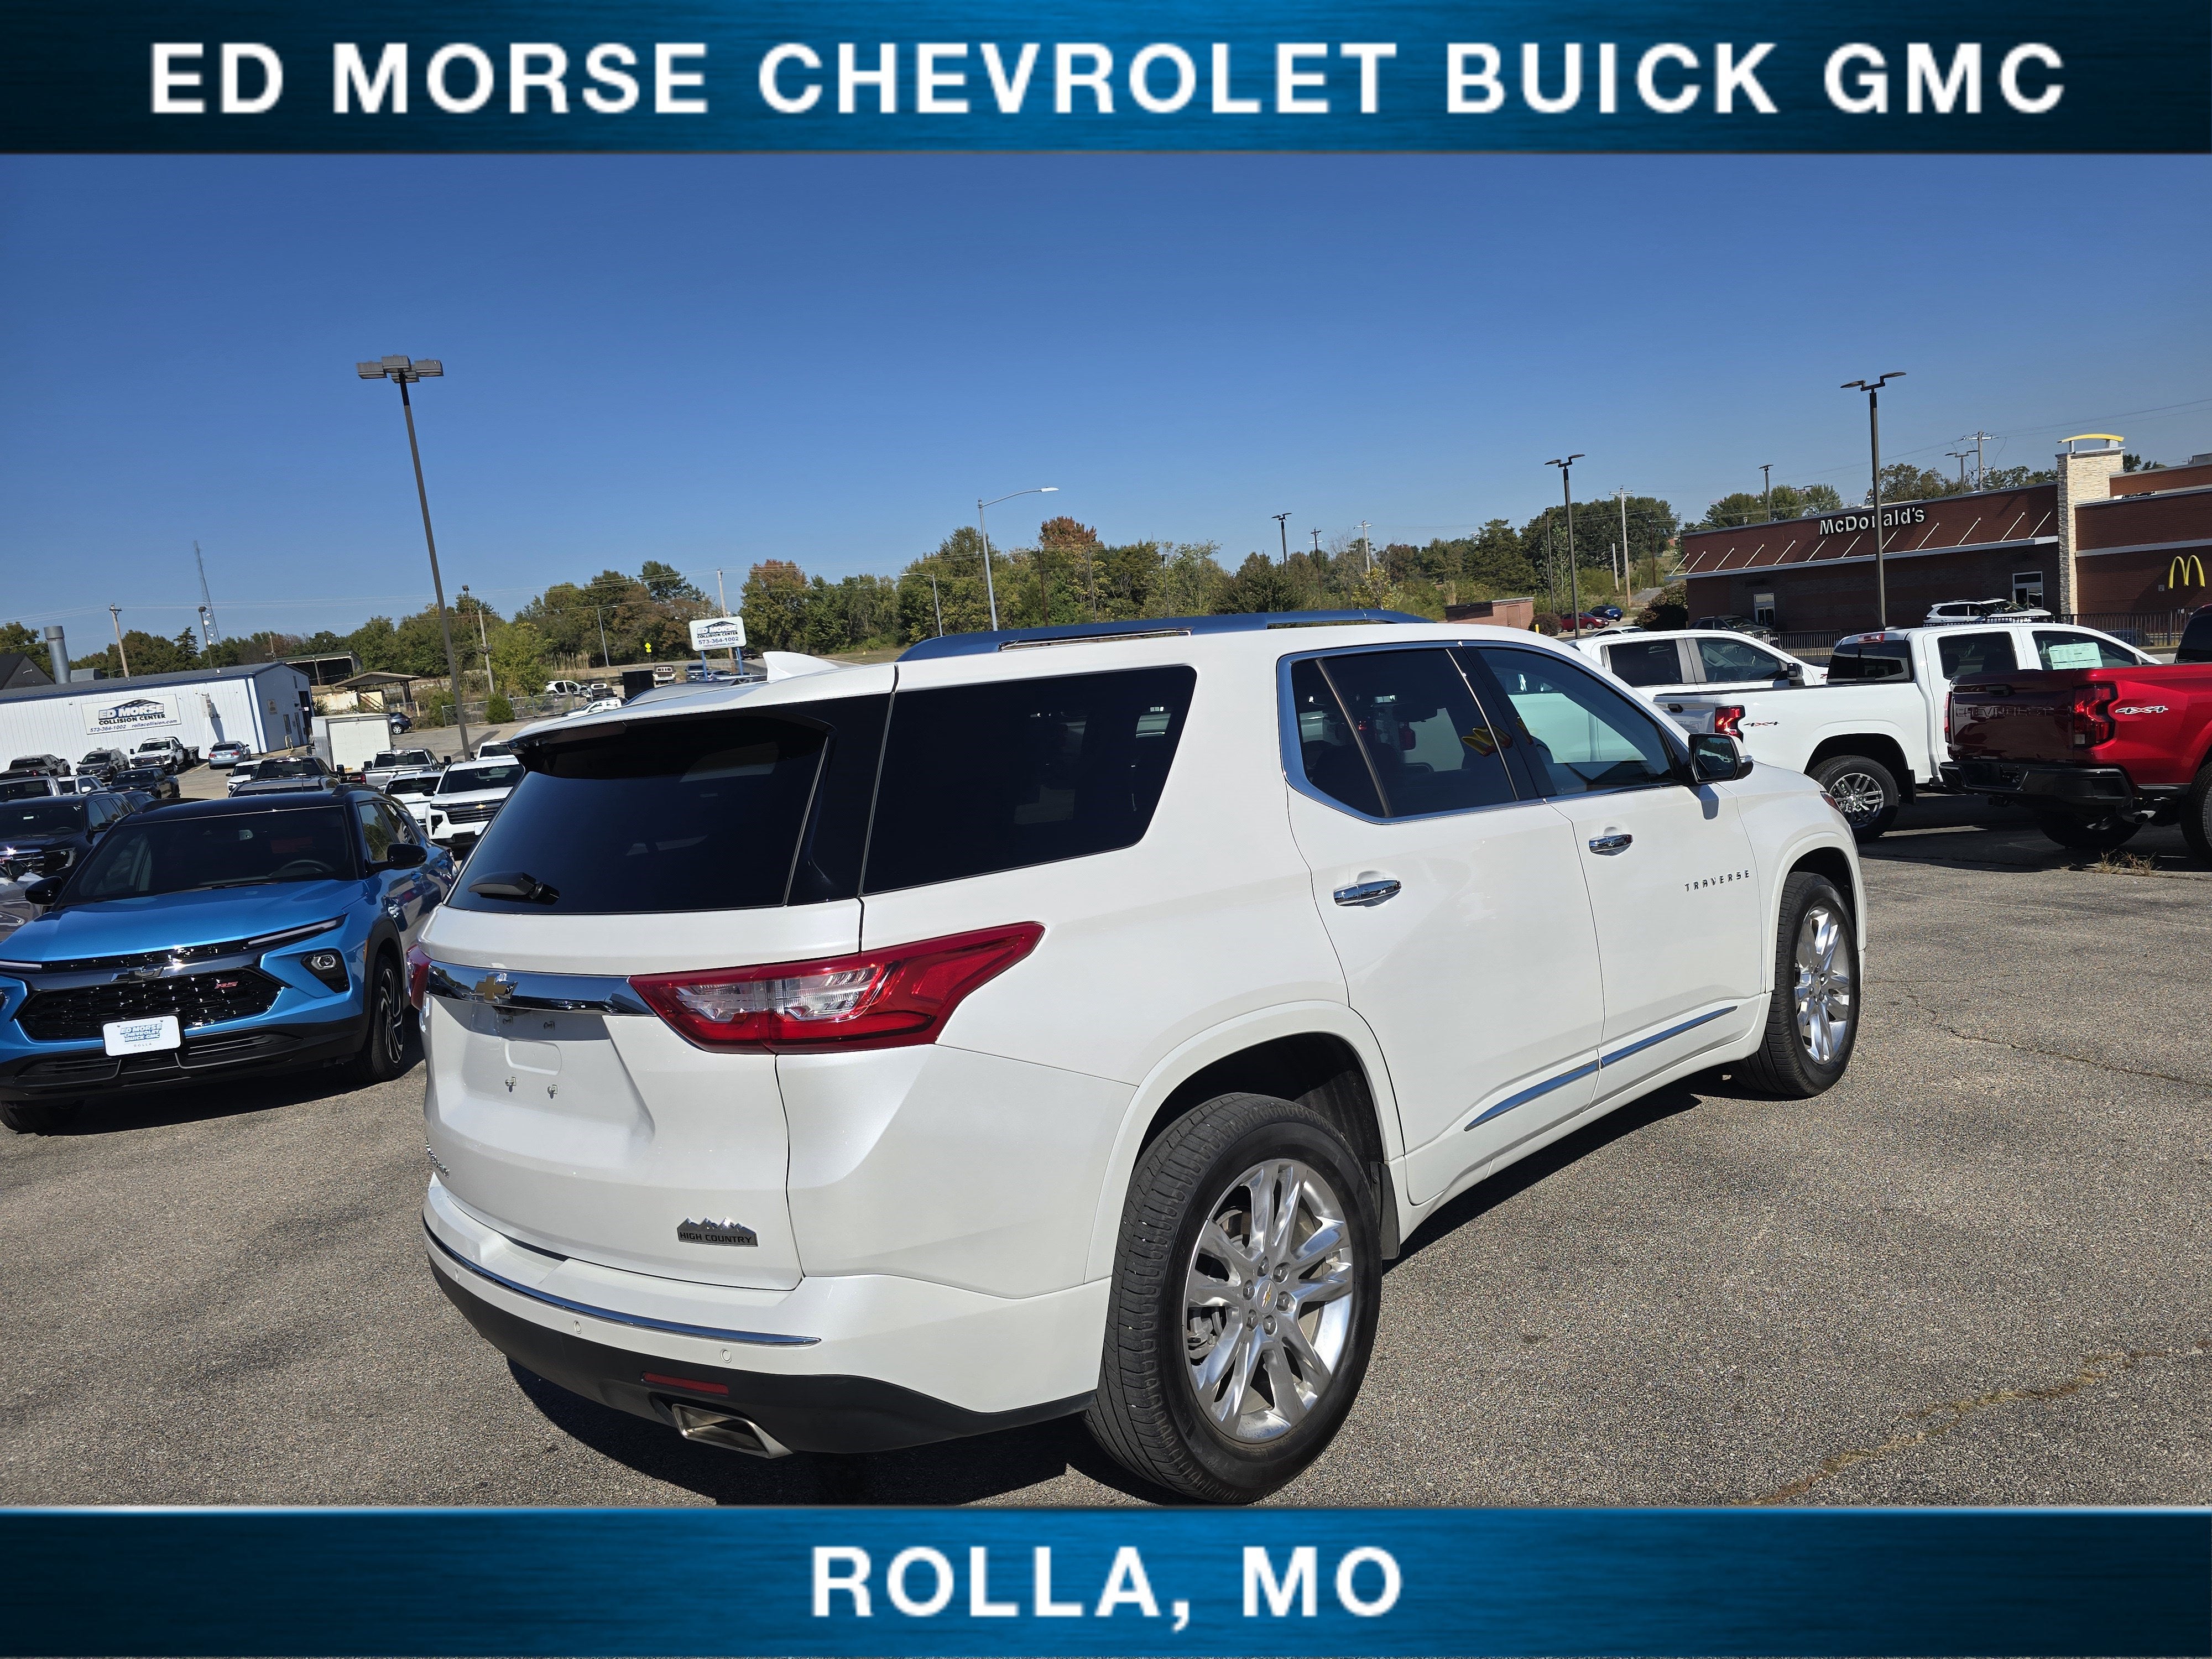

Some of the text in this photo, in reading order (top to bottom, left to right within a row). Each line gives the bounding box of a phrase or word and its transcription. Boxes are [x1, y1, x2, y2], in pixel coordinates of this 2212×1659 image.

[709, 624, 737, 633] MORSE
[98, 703, 164, 720] ED MORSE
[98, 717, 138, 725] COLLISION
[132, 719, 177, 728] rollacollision.com
[1684, 870, 1750, 891] TRAVERSE
[133, 1024, 162, 1032] MORSE
[680, 1232, 752, 1243] HIGH COUNTRY
